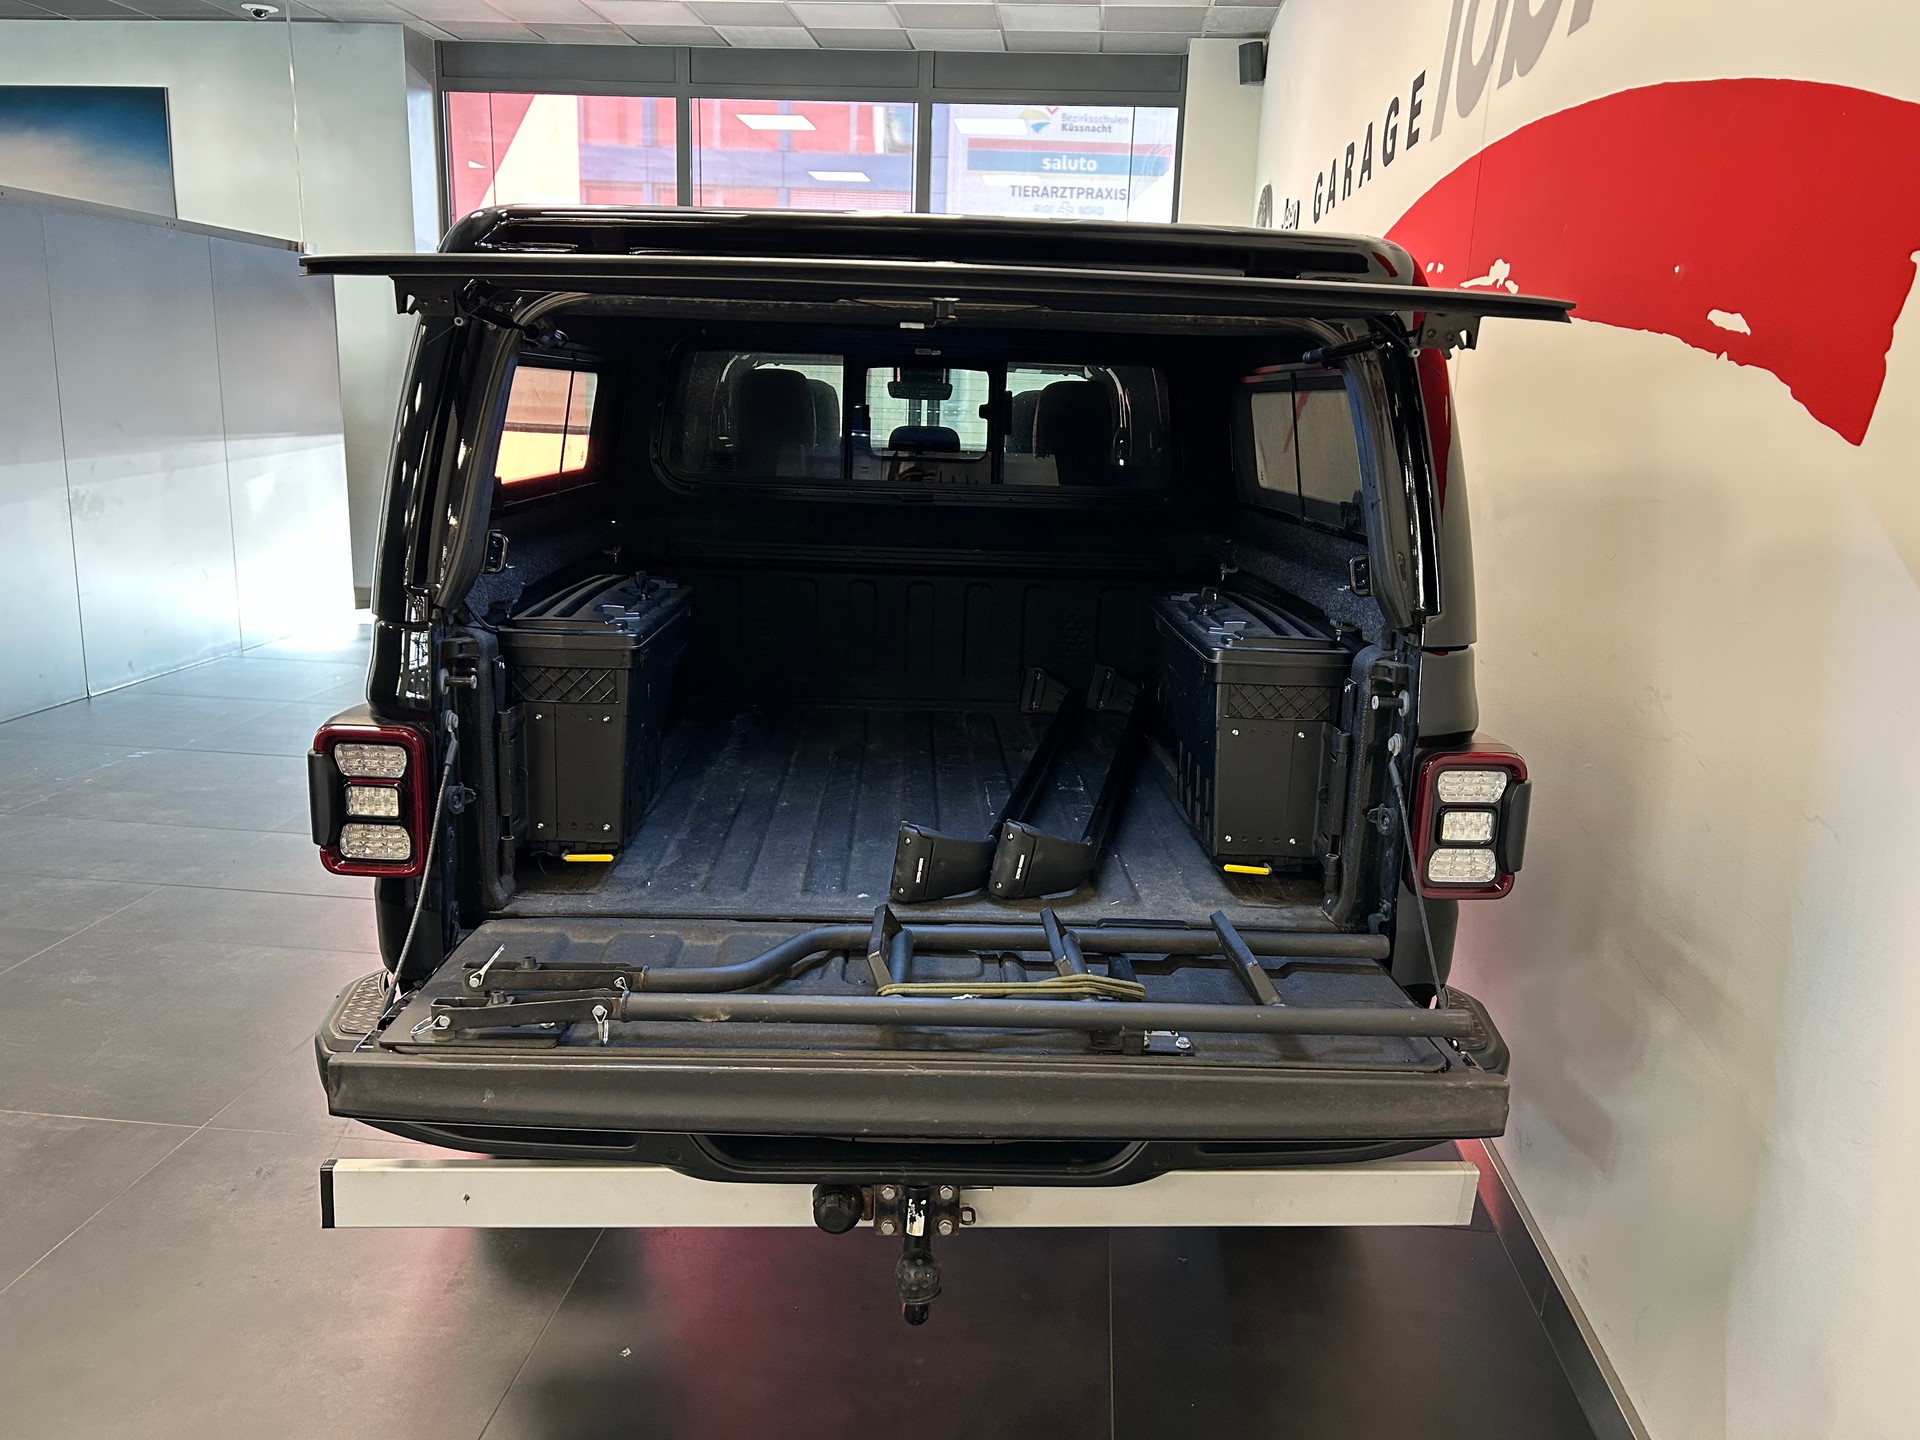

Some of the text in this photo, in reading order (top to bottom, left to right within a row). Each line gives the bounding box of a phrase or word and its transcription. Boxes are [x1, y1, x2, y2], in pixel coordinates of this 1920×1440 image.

[1061, 123, 1112, 133] Küssnacht
[1313, 69, 1426, 224] GARAGE
[1042, 154, 1097, 171] saluto
[1010, 185, 1127, 200] TIERARZTPRAXIS
